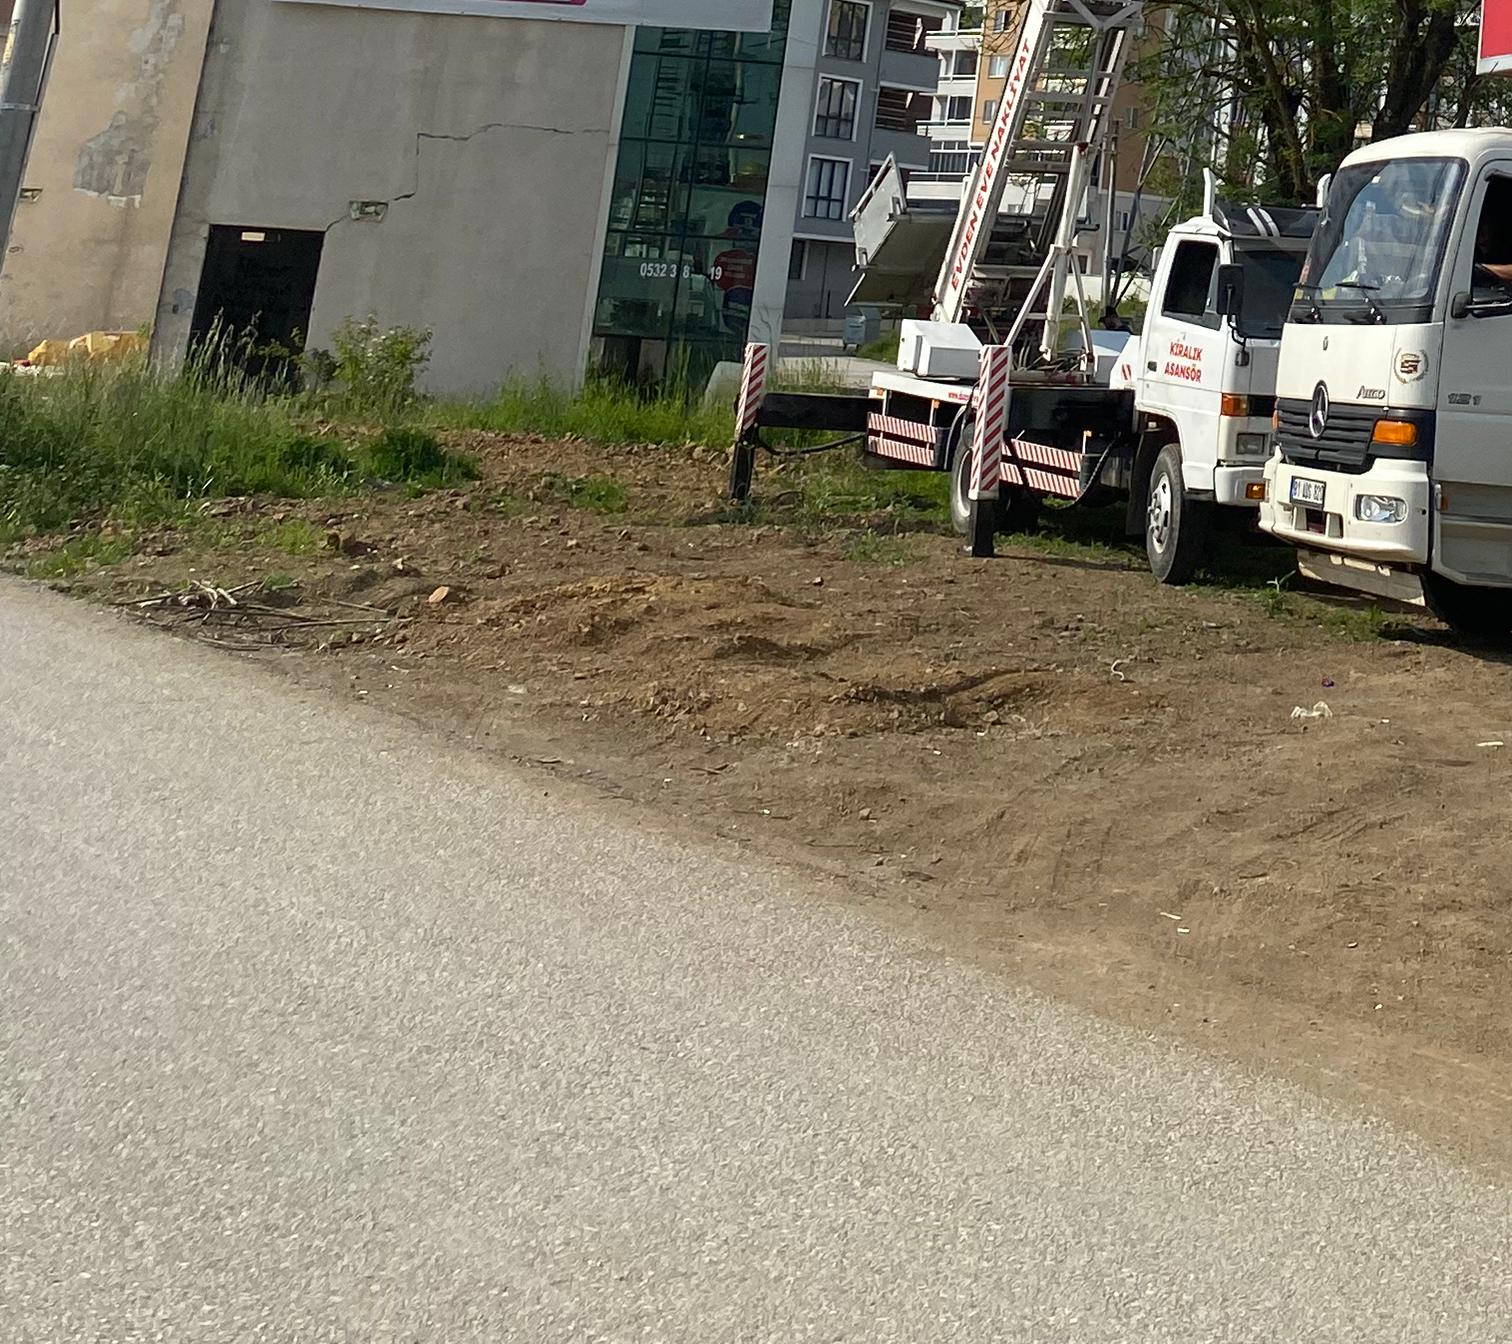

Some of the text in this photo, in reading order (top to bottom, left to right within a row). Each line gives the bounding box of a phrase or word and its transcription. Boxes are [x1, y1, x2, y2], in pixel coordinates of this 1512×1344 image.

[951, 209, 978, 293] EVDEN
[976, 161, 993, 205] EVE
[640, 262, 668, 278] 0532
[1164, 361, 1202, 383] ASANSÖR
